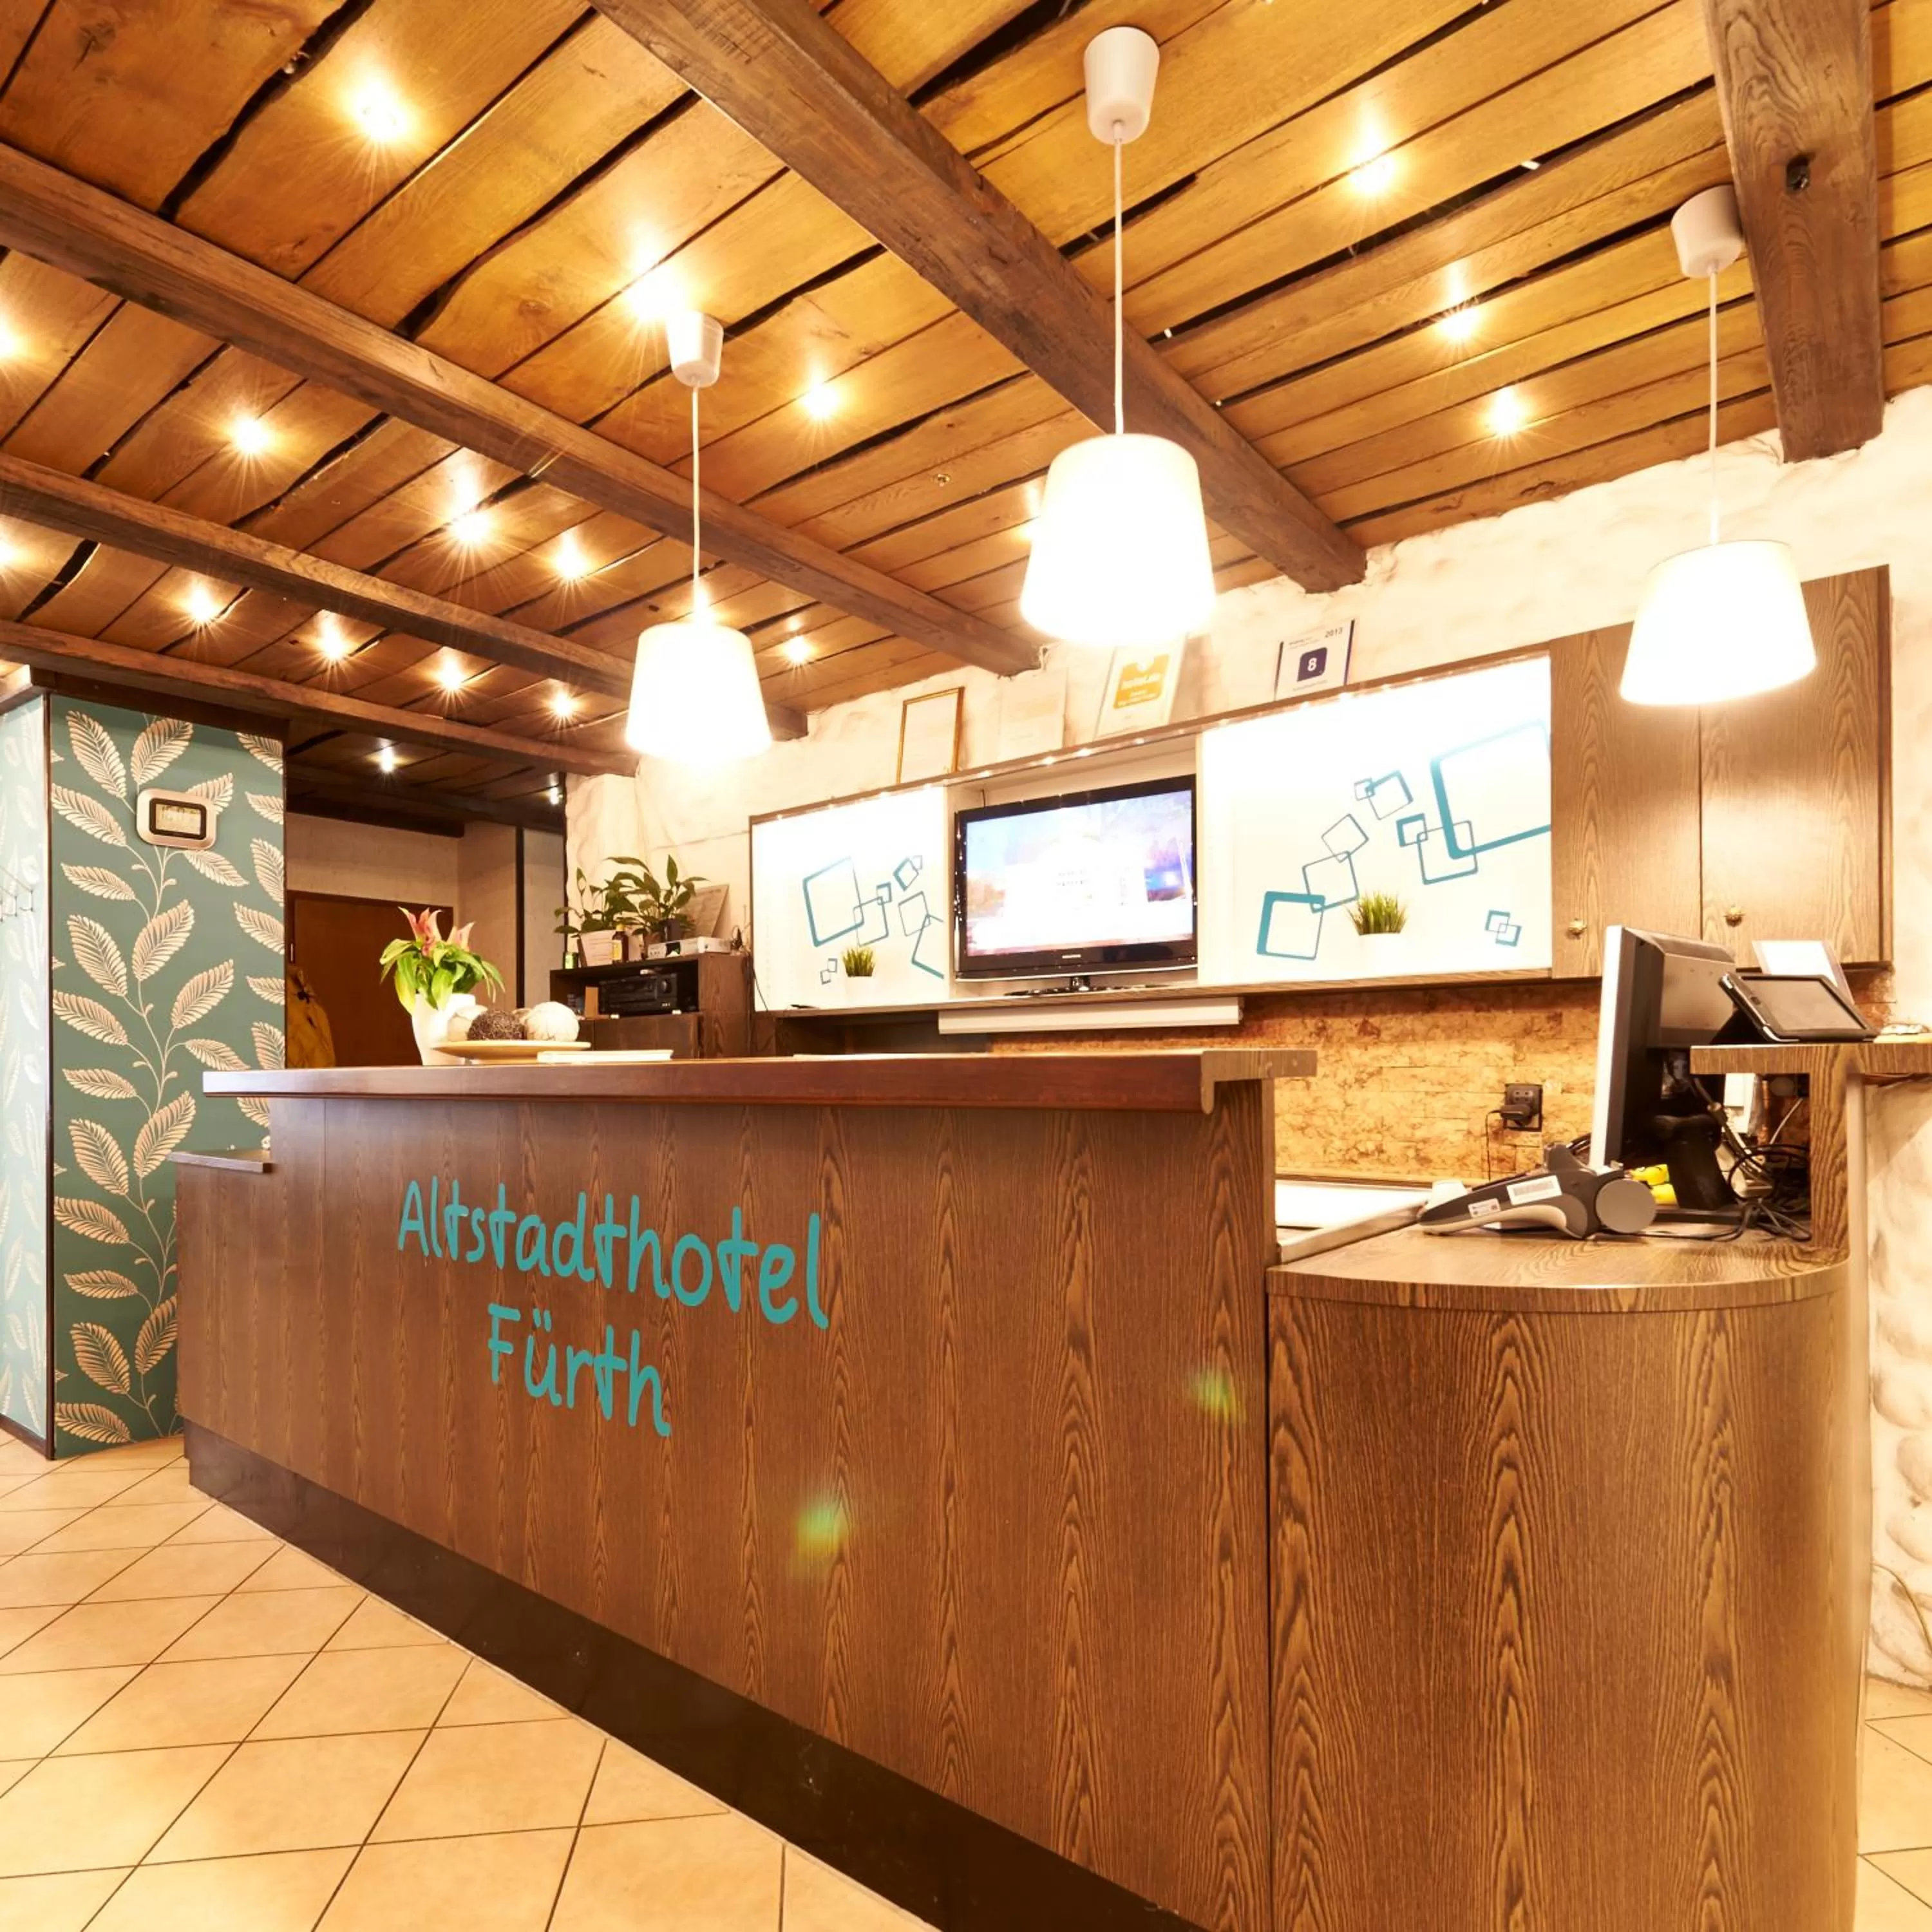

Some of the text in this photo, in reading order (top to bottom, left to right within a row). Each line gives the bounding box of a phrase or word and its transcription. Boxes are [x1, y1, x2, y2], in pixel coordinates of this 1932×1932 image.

[1307, 657, 1318, 672] 8
[398, 1175, 829, 1329] Altstadthotel
[488, 1303, 670, 1437] Fürth
